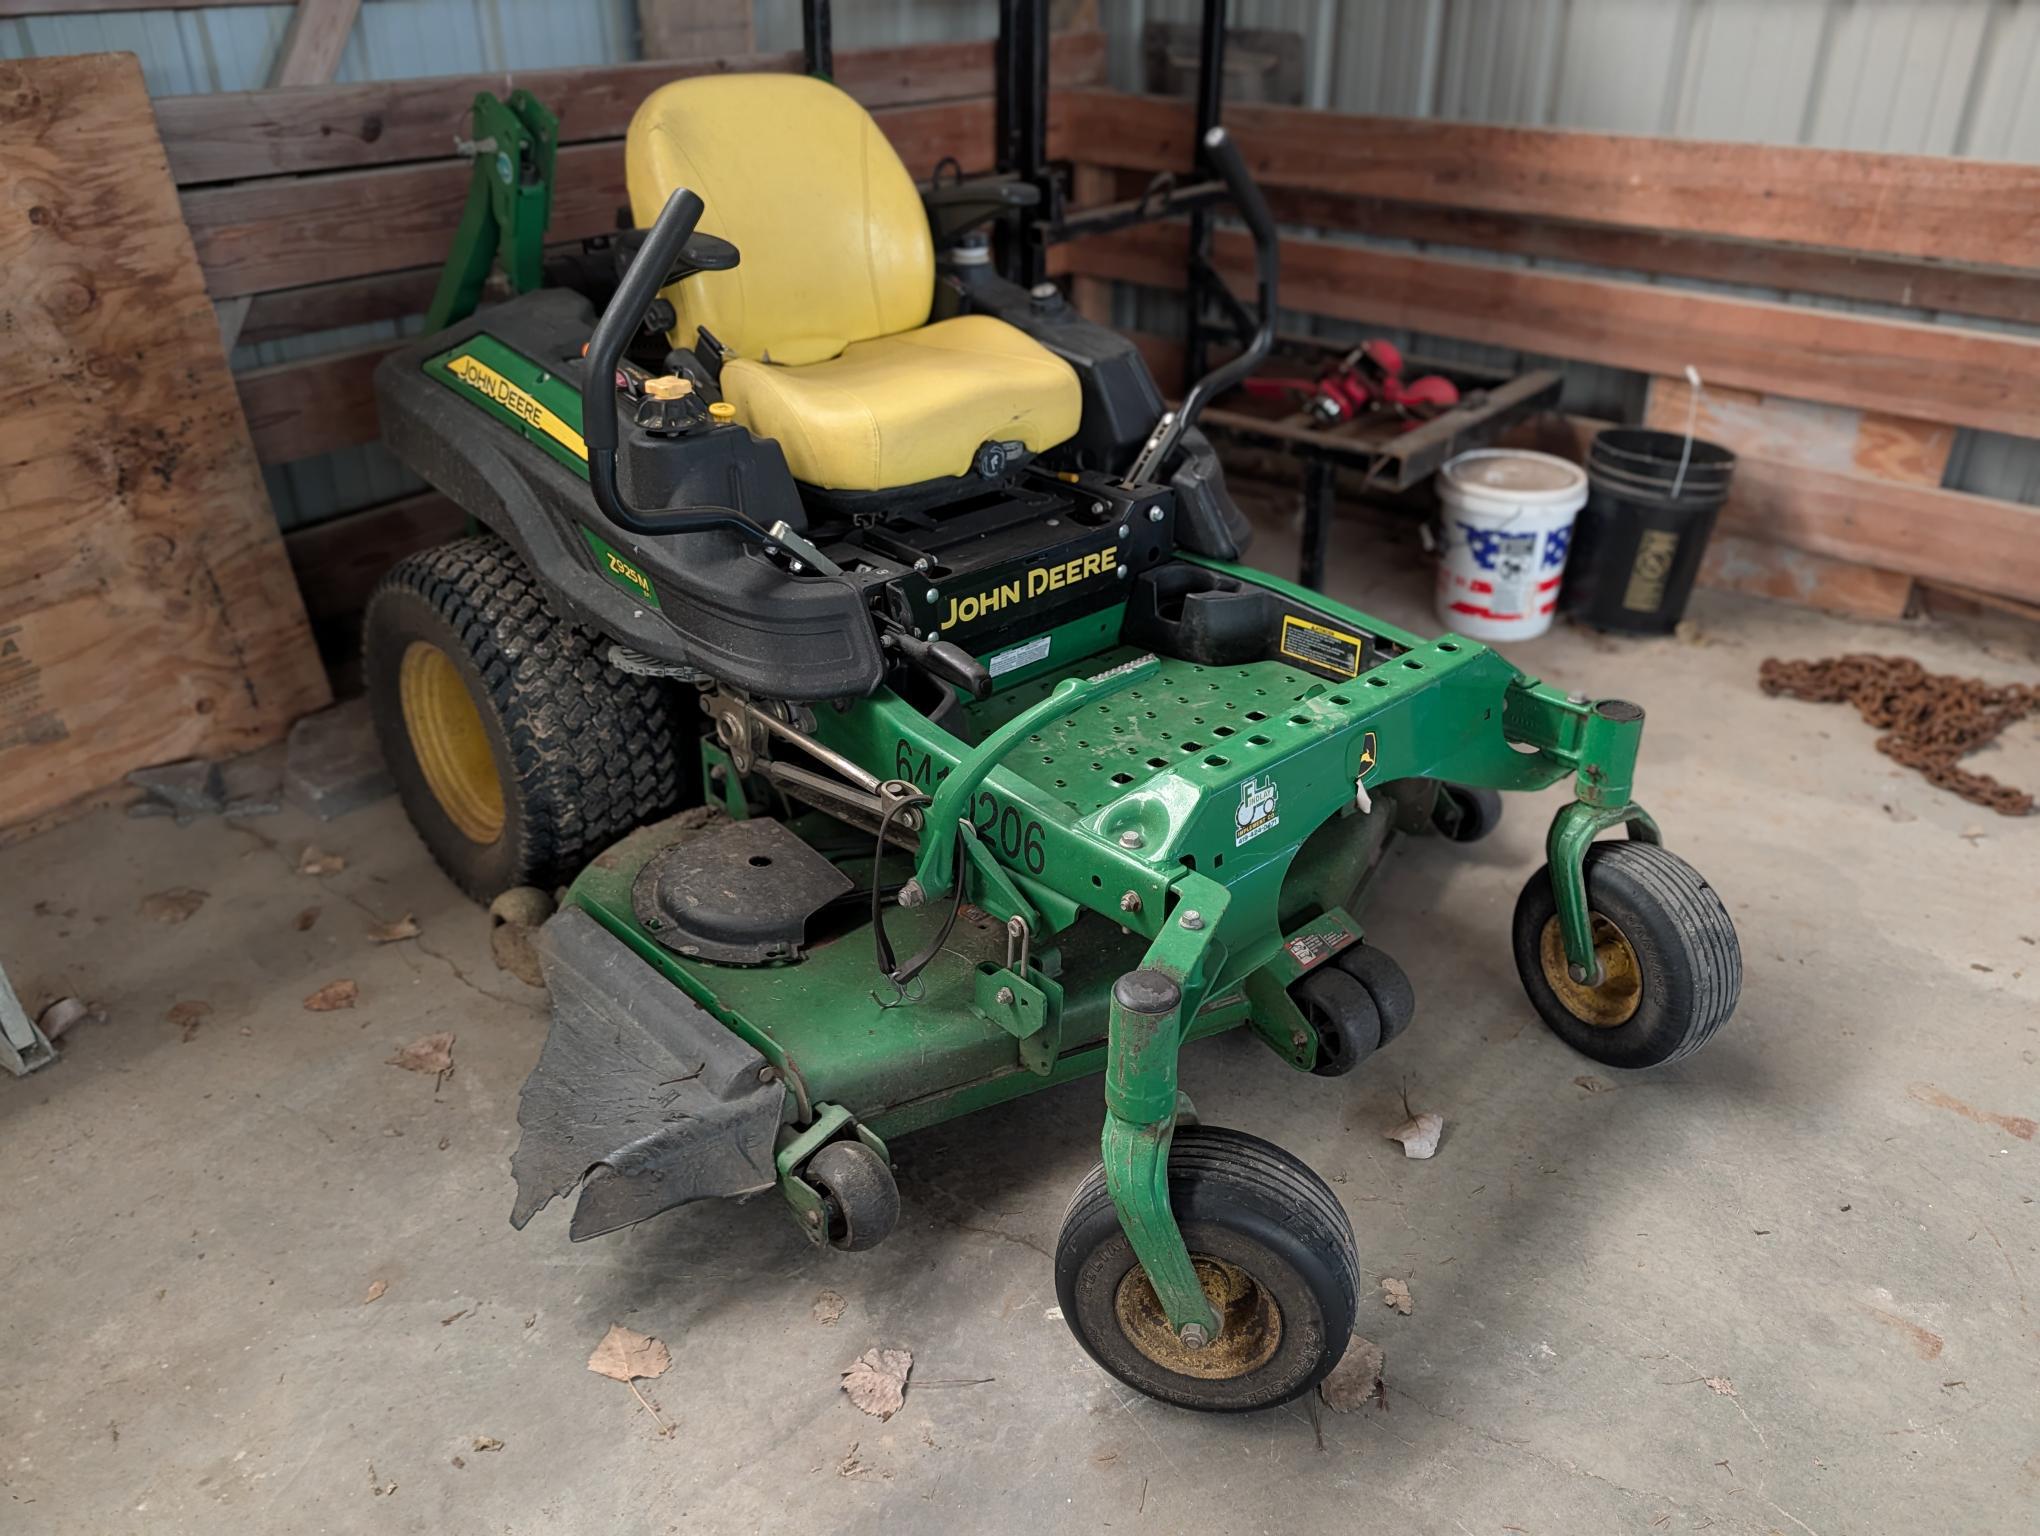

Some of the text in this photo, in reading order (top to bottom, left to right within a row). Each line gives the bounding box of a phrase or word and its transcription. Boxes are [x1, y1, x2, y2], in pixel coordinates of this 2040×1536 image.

[460, 360, 542, 425] JOHN DEERE
[607, 552, 650, 591] Z925M
[940, 546, 1117, 630] JOHN DEERE
[1237, 817, 1266, 837] IMPLEMENT
